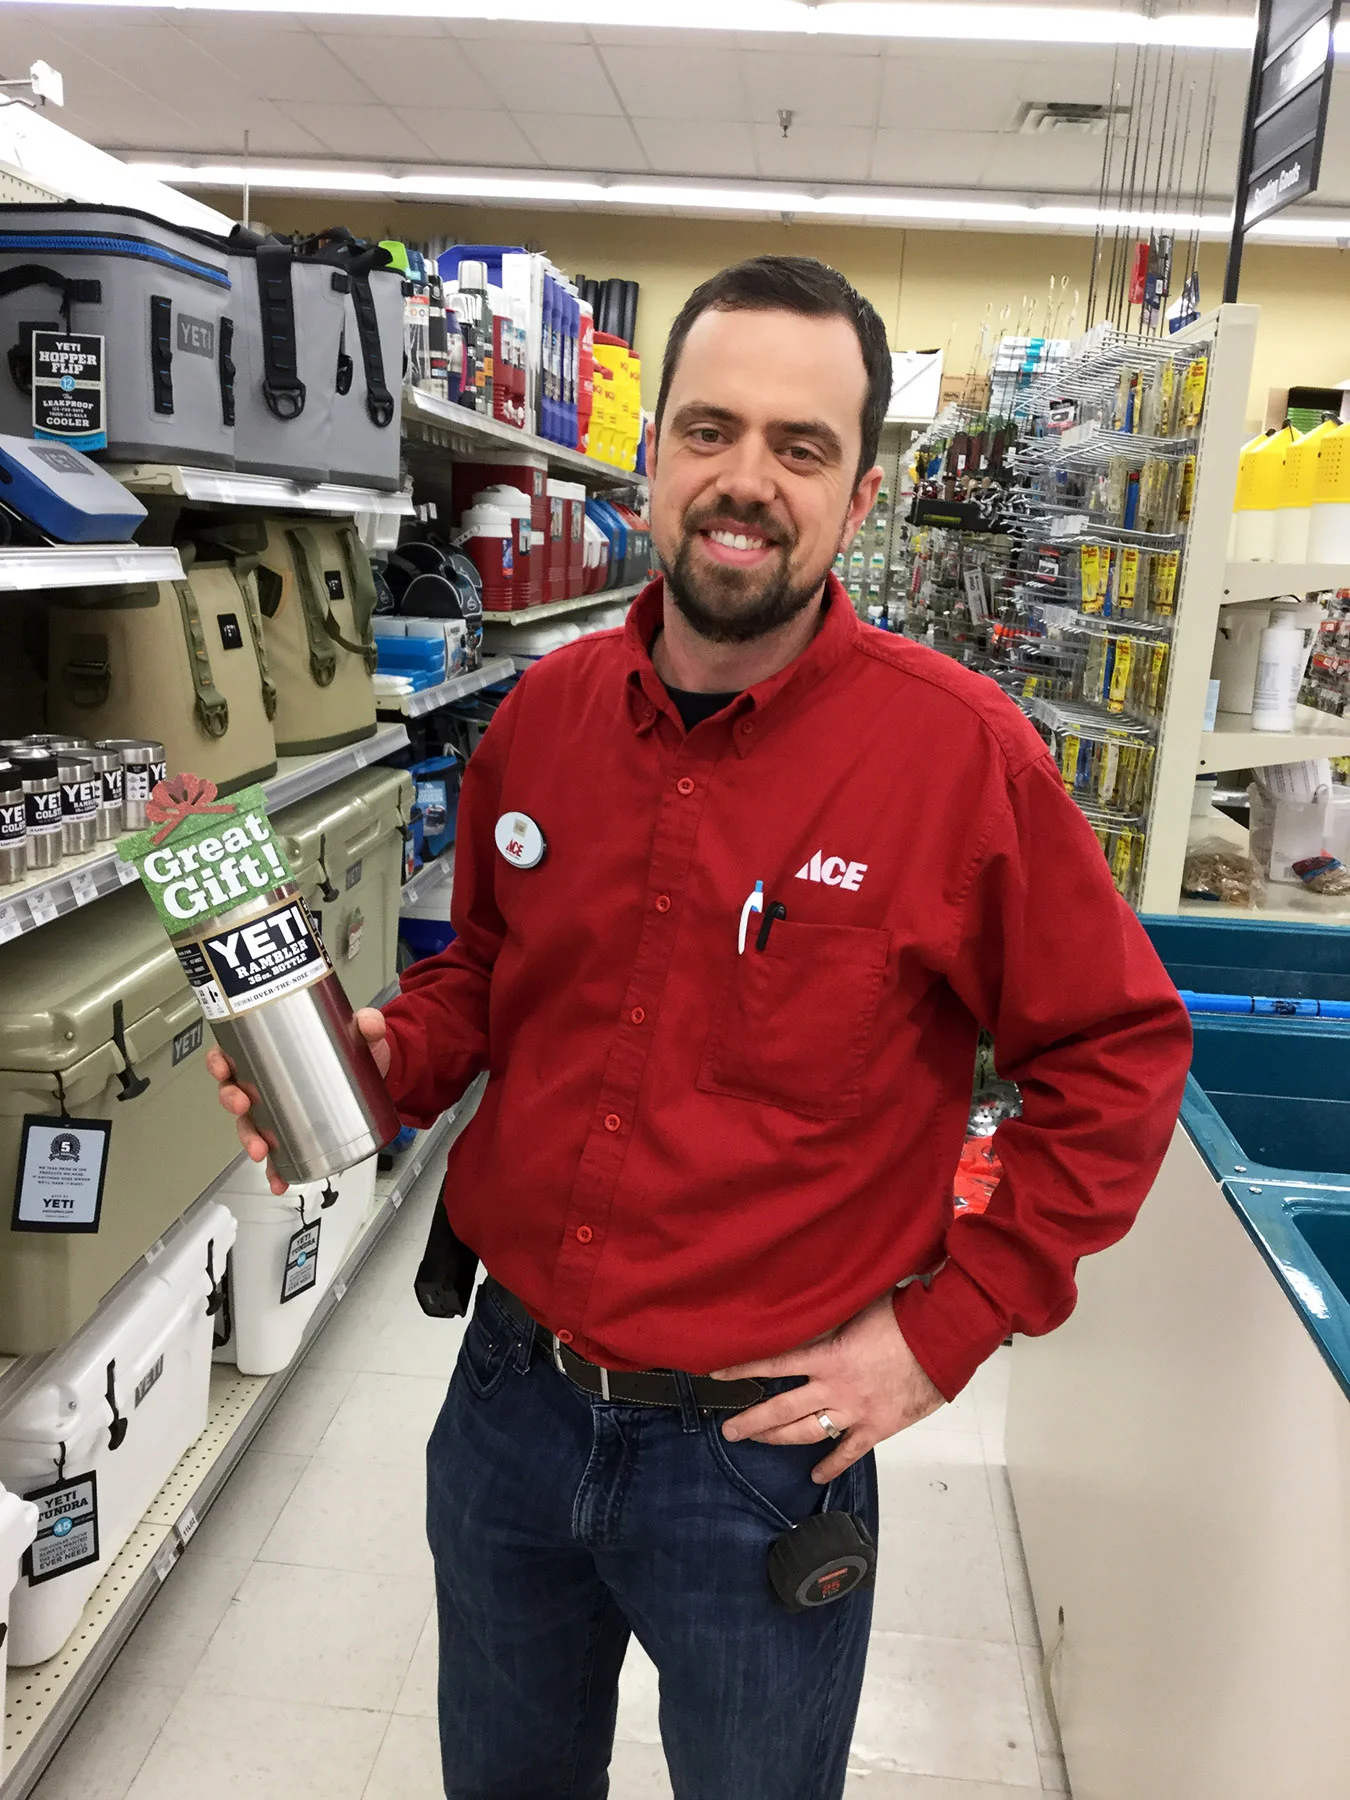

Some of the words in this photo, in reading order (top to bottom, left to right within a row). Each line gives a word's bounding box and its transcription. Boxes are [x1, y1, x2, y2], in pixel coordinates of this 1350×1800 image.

[180, 321, 212, 350] YETI
[55, 341, 81, 352] YETI
[39, 351, 97, 366] HOPPER
[51, 362, 84, 374] FLIP
[62, 378, 73, 388] 12
[43, 400, 94, 410] LEAKPROOF
[46, 417, 90, 427] COOLER
[143, 813, 270, 883] Great
[795, 849, 868, 891] ACE
[208, 905, 309, 969] YETI
[235, 939, 308, 979] RAMBLER
[272, 953, 308, 976] BOTTLE
[174, 1023, 201, 1060] YETI
[60, 1141, 71, 1152] 5
[42, 1198, 75, 1209] YETI
[137, 1358, 162, 1398] YETI
[45, 1490, 77, 1508] YETI
[38, 1498, 89, 1522] TUNDRA
[54, 1521, 72, 1533] 45
[40, 1556, 63, 1570] EVER
[64, 1546, 88, 1560] NEED
